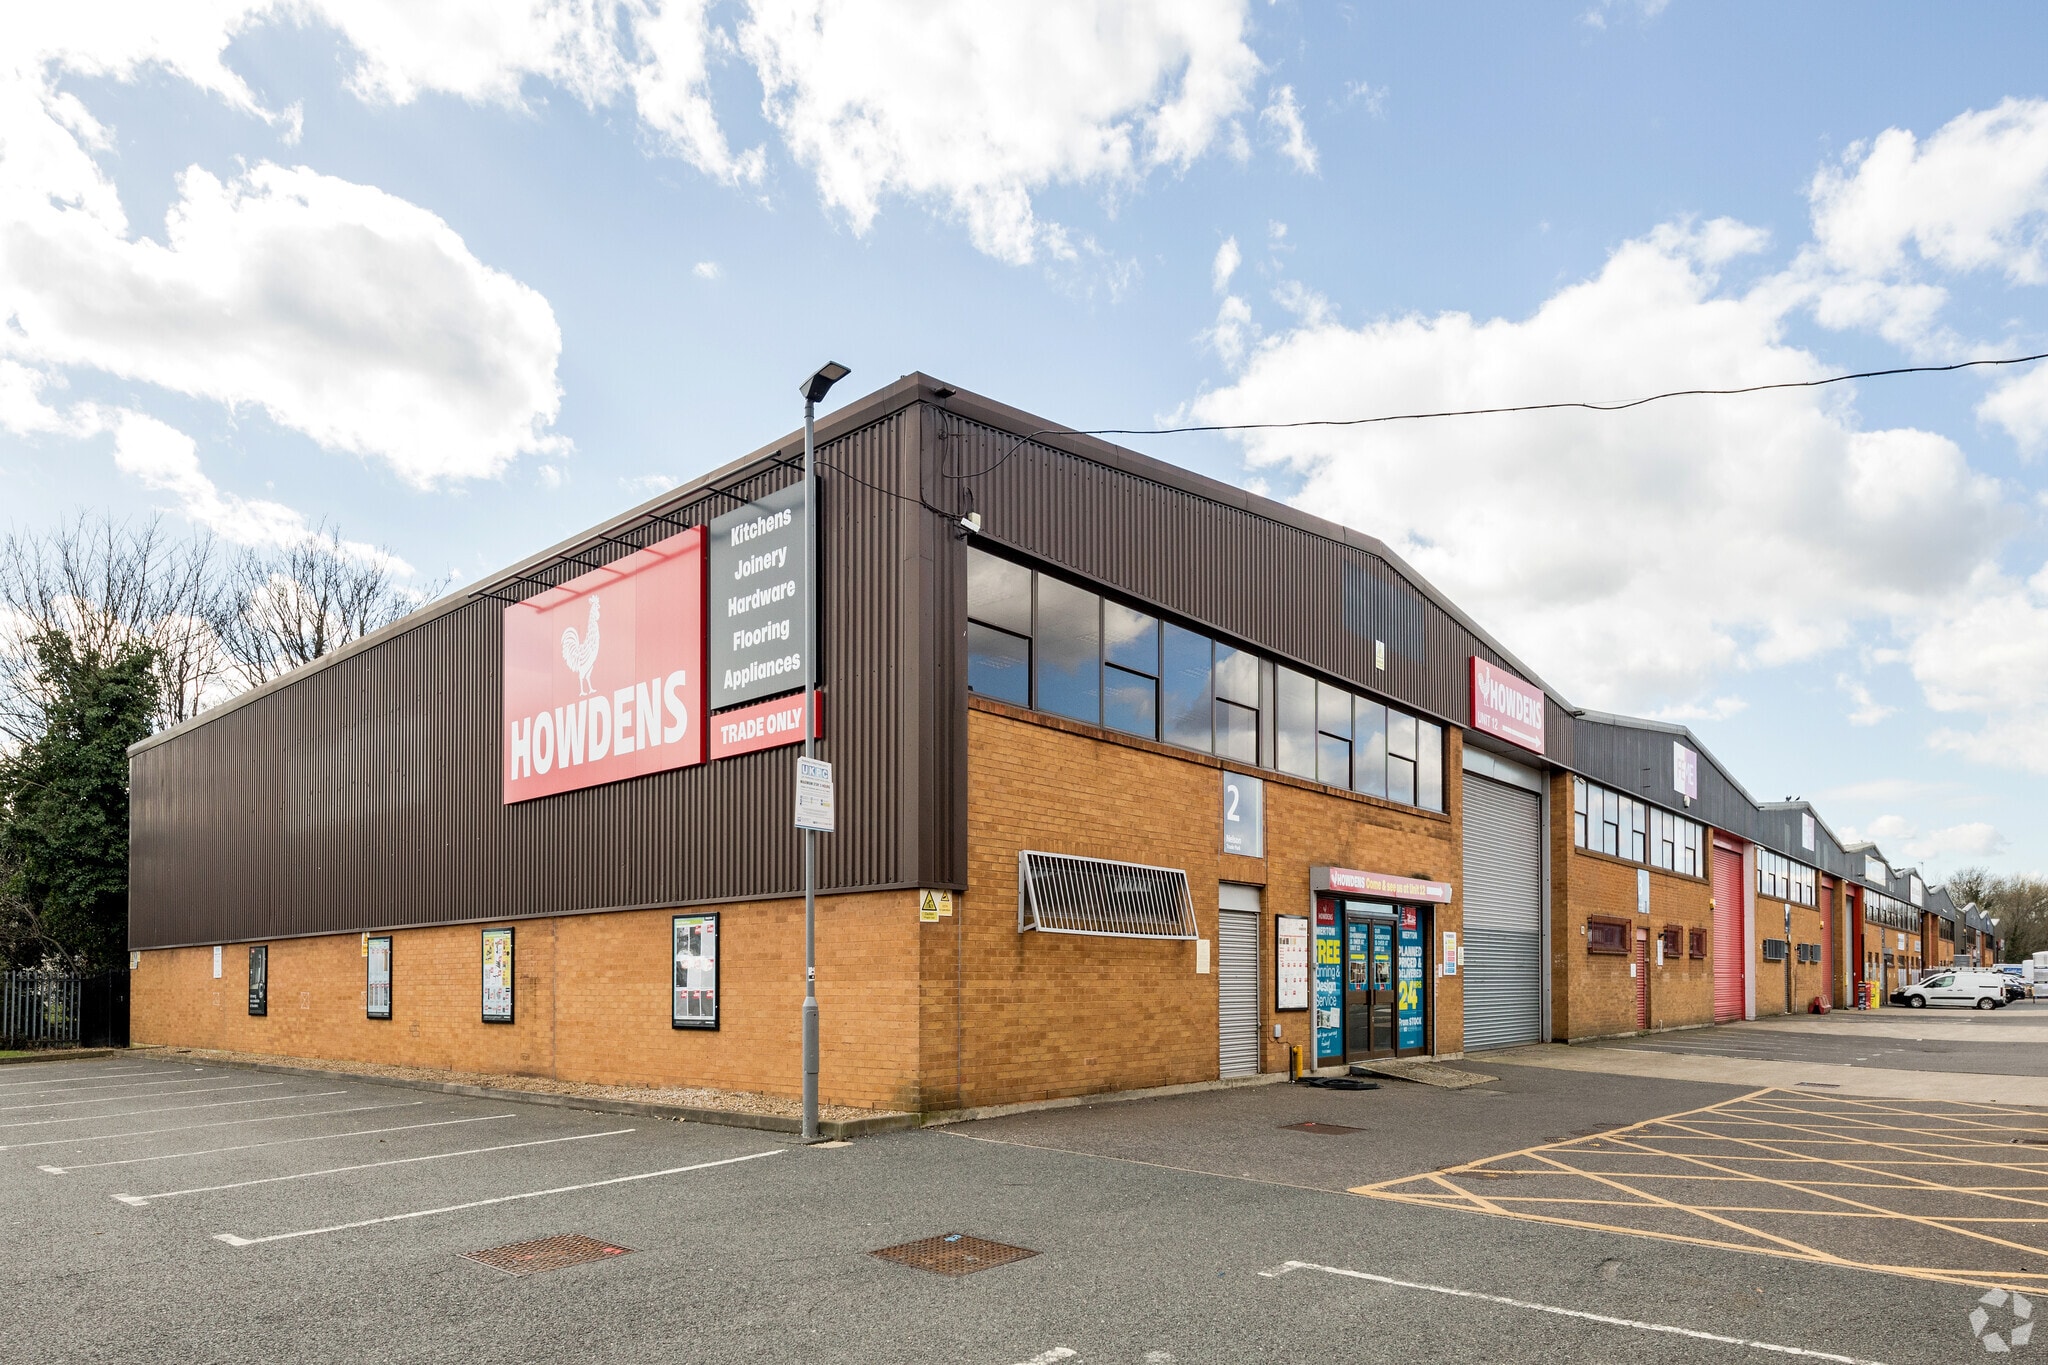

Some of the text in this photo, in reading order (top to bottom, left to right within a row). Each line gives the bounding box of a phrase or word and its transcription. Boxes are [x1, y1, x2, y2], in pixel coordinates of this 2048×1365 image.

[731, 508, 792, 547] Kitchens
[734, 545, 787, 581] Joinery
[728, 579, 796, 617] Hardware
[733, 619, 790, 651] Flooring
[723, 653, 801, 690] Appliances
[1477, 711, 1498, 731] UNIT 12
[1490, 683, 1542, 730] HOWDENS
[511, 670, 688, 781] HOWDENS
[721, 707, 803, 745] TRADE ONLY
[801, 764, 829, 780] UKPC
[1227, 784, 1240, 822] 2
[1226, 834, 1241, 844] Nelson
[1337, 873, 1365, 889] HOWDENS
[1366, 877, 1381, 890] Come
[1382, 880, 1387, 891] &
[1399, 946, 1422, 957] PLANNED
[1399, 957, 1417, 968] PRICED
[1399, 969, 1422, 978] DELIVERED
[1399, 980, 1417, 1010] 24
[1409, 1017, 1422, 1026] STOCK
